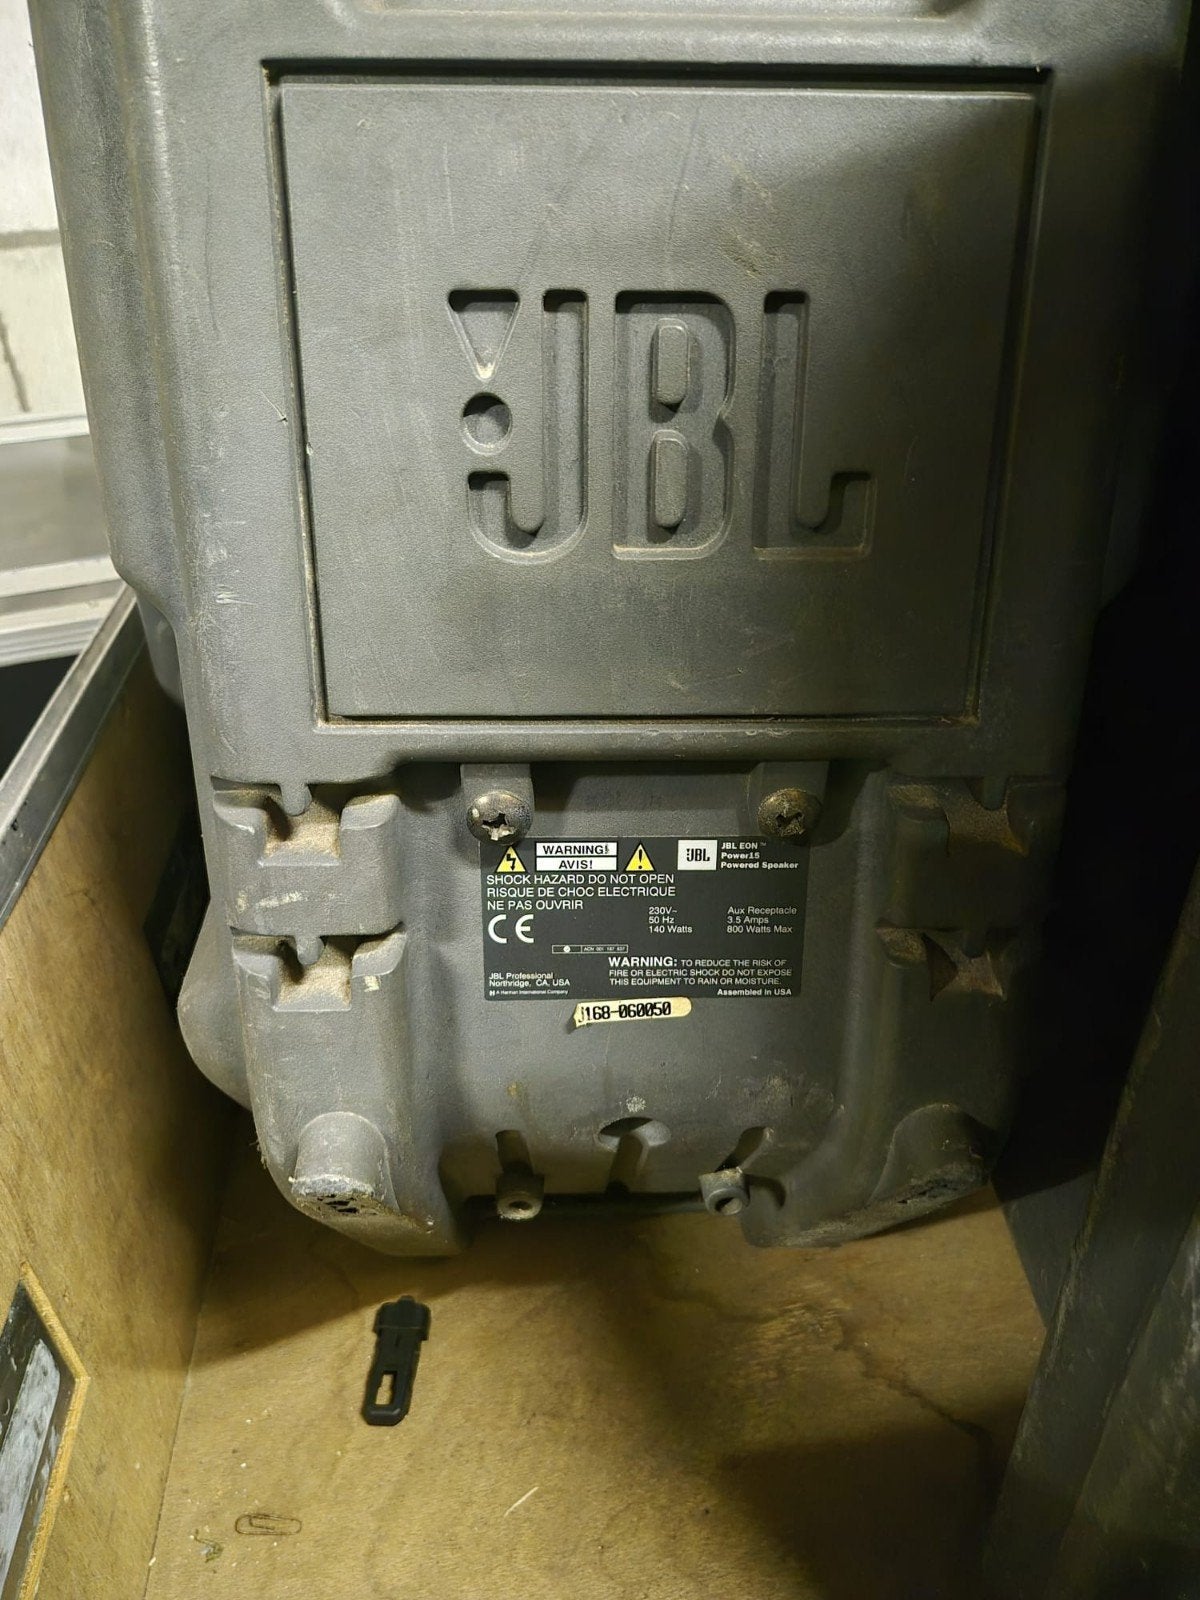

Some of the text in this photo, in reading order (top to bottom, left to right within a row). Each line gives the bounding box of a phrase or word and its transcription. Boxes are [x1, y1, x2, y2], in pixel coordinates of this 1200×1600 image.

[449, 289, 877, 563] JBL
[542, 845, 610, 855] WARNING!
[721, 842, 737, 850] JBL
[686, 848, 710, 861] JBL
[721, 852, 760, 860] Power15
[558, 859, 593, 870] AVIS!
[721, 861, 799, 870] Powered Speaker
[486, 874, 675, 885] SHOCK HAZARD DO NOT OPEN
[487, 886, 676, 898] RISQUE DE CHOC ELECTRIQUE
[487, 900, 584, 911] NE PAS OUVRIR
[727, 906, 798, 916] Aux Receptacle
[648, 916, 675, 925] 50 Hz
[743, 915, 770, 926] Amps
[648, 924, 693, 934] 140 Watts
[726, 925, 793, 934] 800 Watts Max
[608, 956, 678, 967] WARNING:
[733, 959, 750, 967] THE
[506, 972, 554, 980] Professional
[609, 969, 629, 977] FIRE
[630, 969, 644, 977] OR
[757, 968, 792, 977] EXPOSE
[610, 978, 629, 986] THIS
[631, 978, 682, 986] EQUIPMENT
[734, 977, 782, 985] MOISTURE.
[717, 988, 762, 996] Assembled
